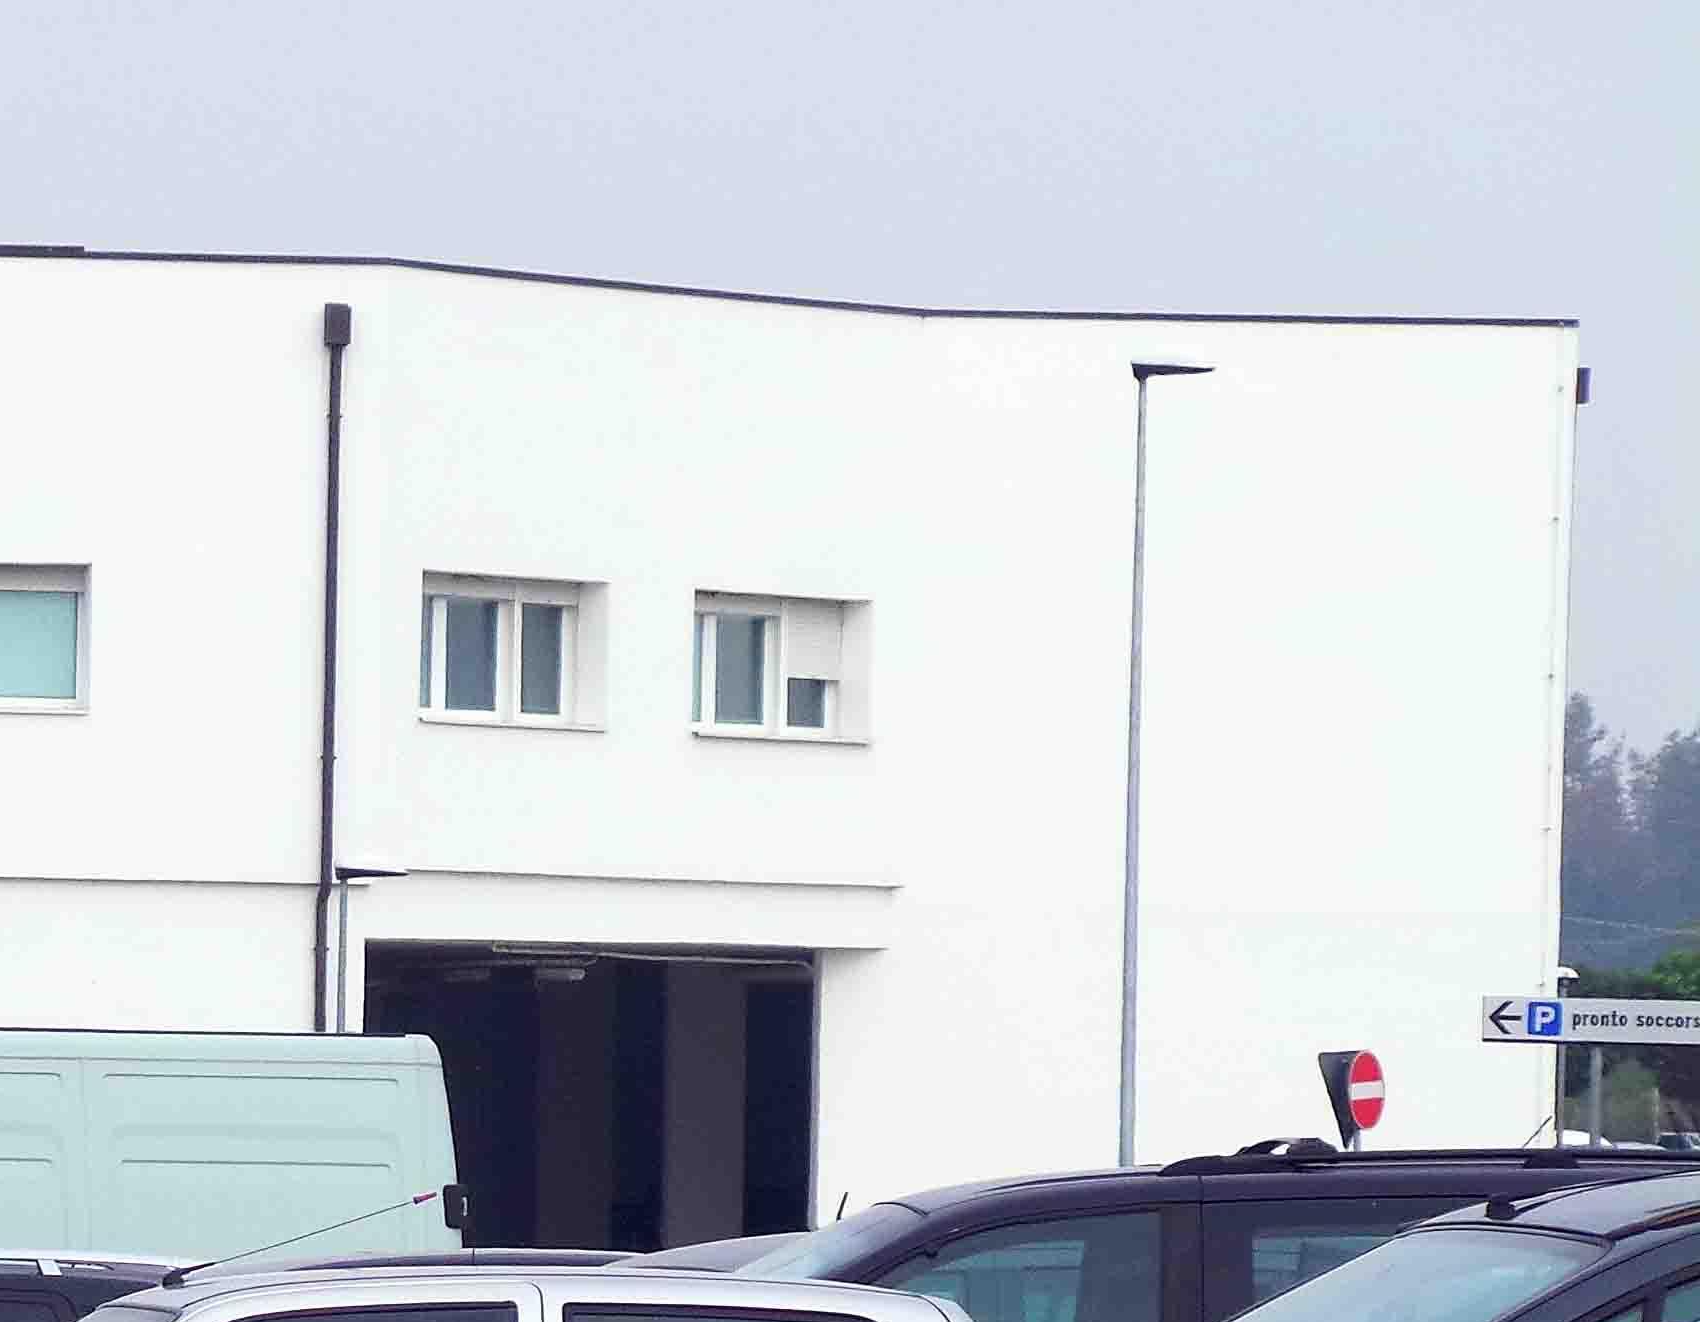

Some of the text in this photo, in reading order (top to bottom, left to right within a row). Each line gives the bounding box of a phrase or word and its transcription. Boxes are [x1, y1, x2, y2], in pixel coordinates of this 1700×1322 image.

[1534, 1005, 1700, 1034] P pronto soccors
